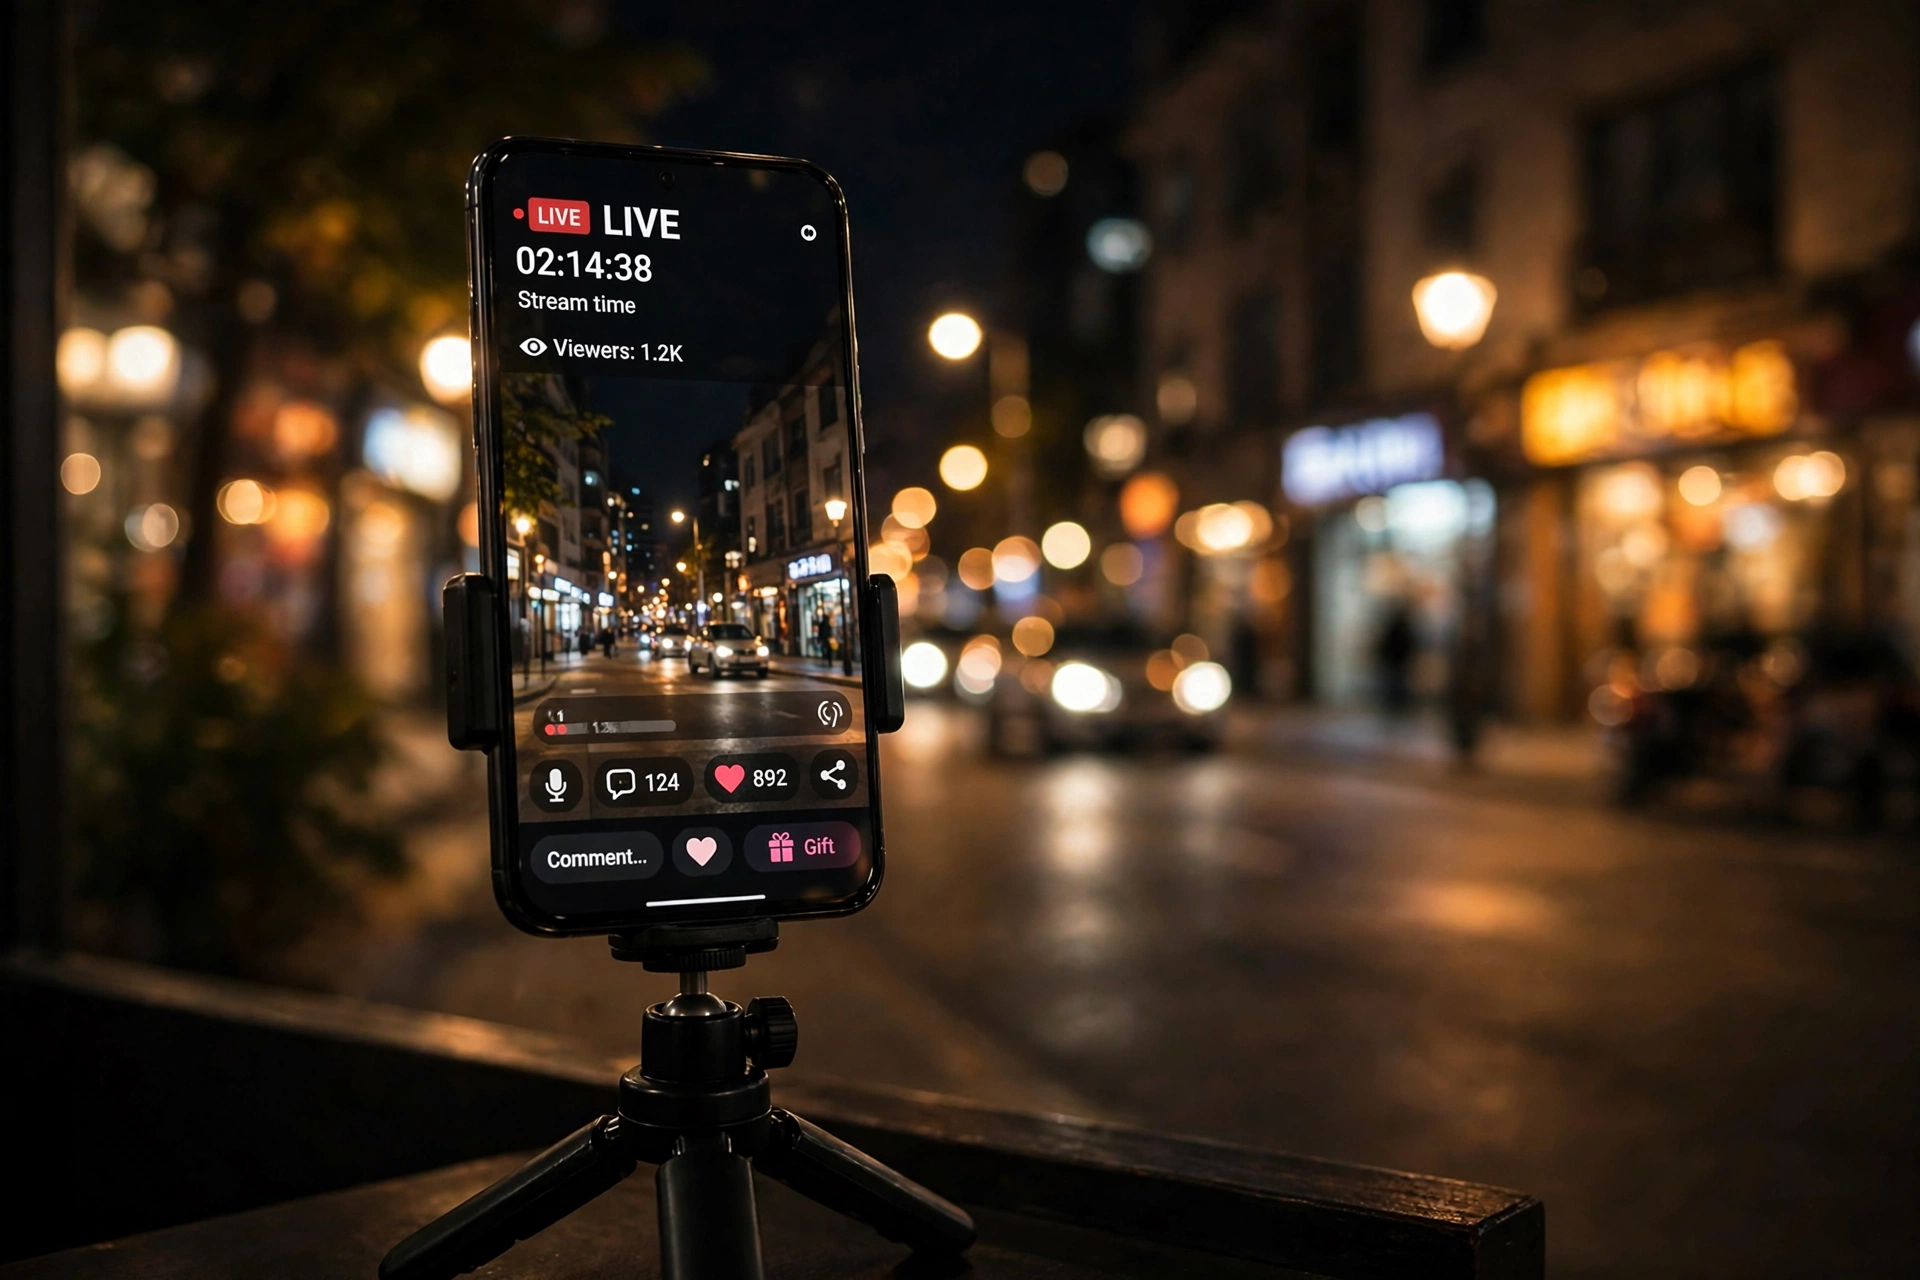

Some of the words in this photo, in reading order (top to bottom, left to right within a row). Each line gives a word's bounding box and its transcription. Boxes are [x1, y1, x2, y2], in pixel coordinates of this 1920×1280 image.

[538, 206, 581, 227] LIVE
[603, 204, 681, 240] LIVE
[516, 246, 652, 282] 02:14:38
[518, 290, 588, 312] Stream
[592, 295, 636, 314] time
[553, 338, 635, 360] Viewers:
[640, 344, 684, 363] 1.2K
[645, 773, 680, 792] 124
[753, 769, 788, 788] 892
[804, 837, 836, 856] Gift
[547, 848, 647, 869] Comment...
